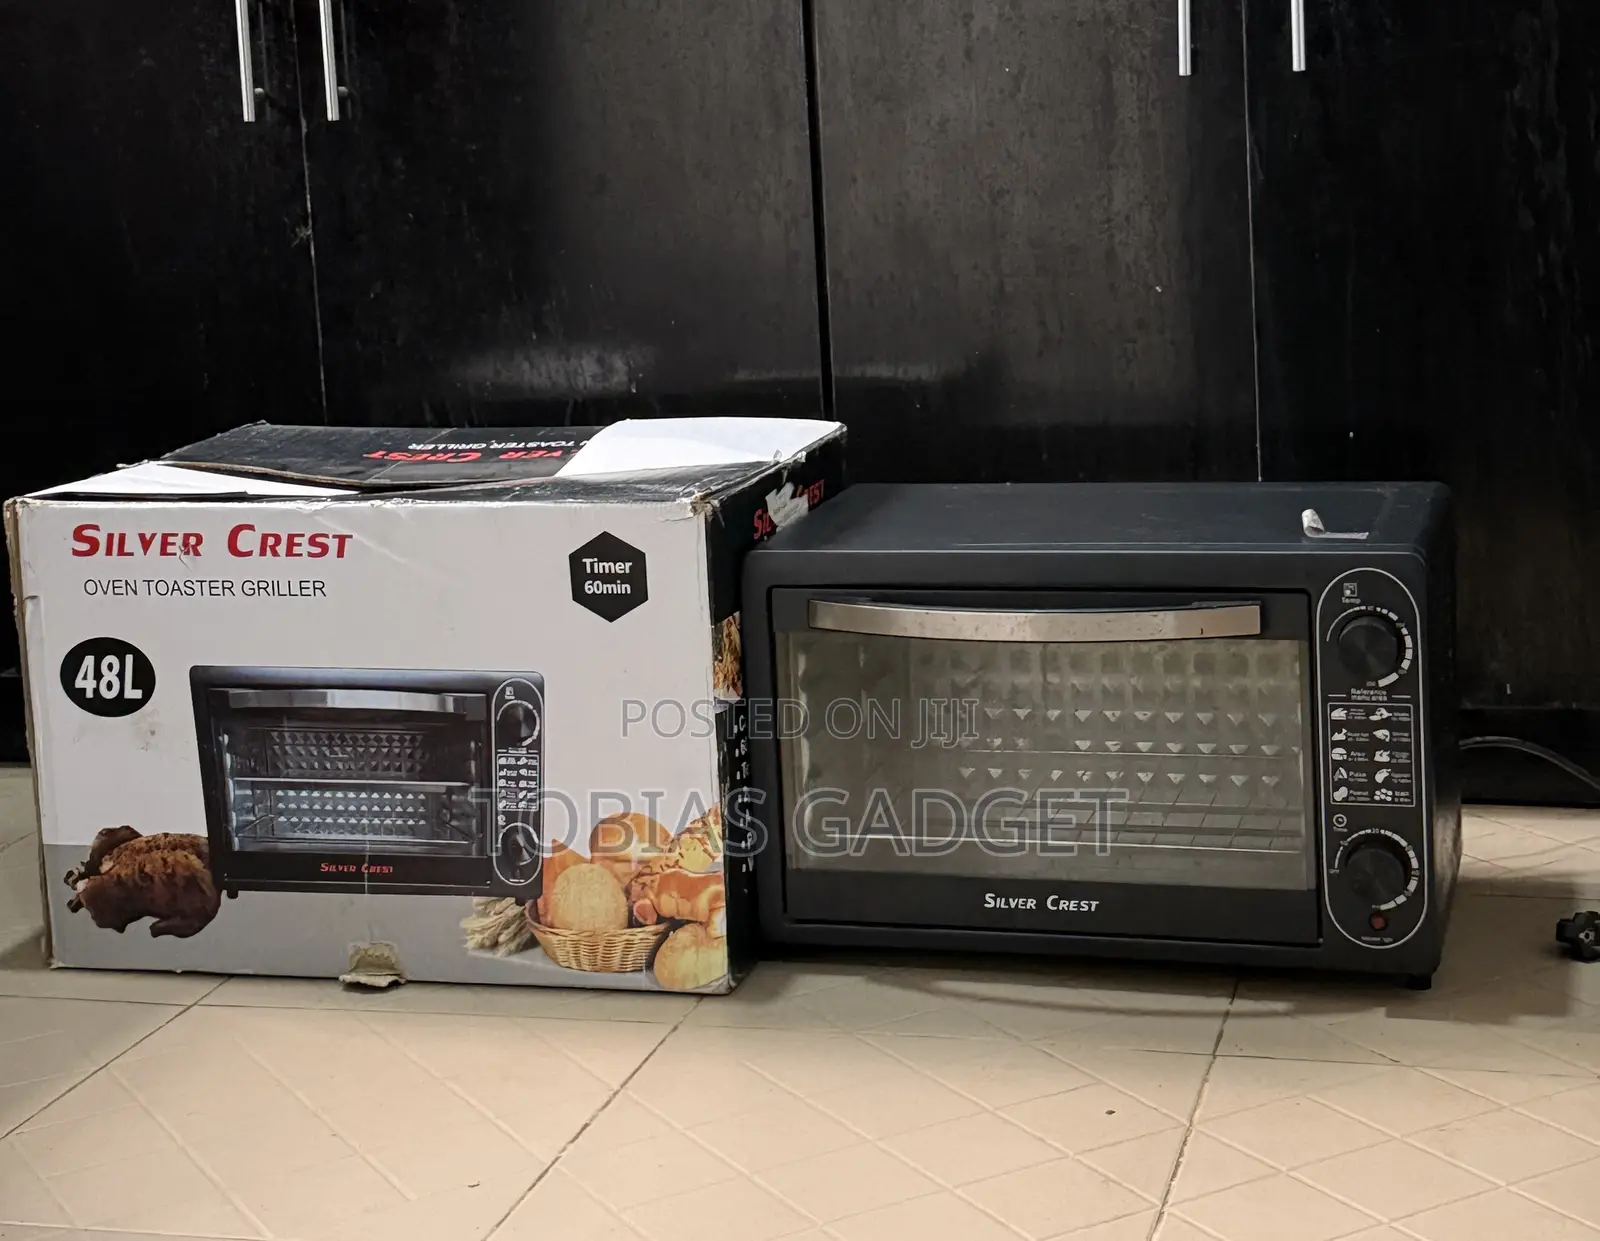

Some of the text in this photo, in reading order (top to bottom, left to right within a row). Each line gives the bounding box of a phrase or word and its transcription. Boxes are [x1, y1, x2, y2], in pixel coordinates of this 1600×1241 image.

[408, 442, 485, 451] GRILLER
[490, 441, 575, 450] TOASTER
[363, 450, 482, 462] CREST
[71, 523, 353, 559] SILVER CREST
[582, 557, 633, 574] Timer
[83, 578, 327, 598] OVEN TOASTER GRILLER
[584, 579, 632, 595] 60min
[74, 653, 143, 700] 48L
[320, 862, 357, 872] SILVER
[984, 892, 1099, 912] SILVER CREST
